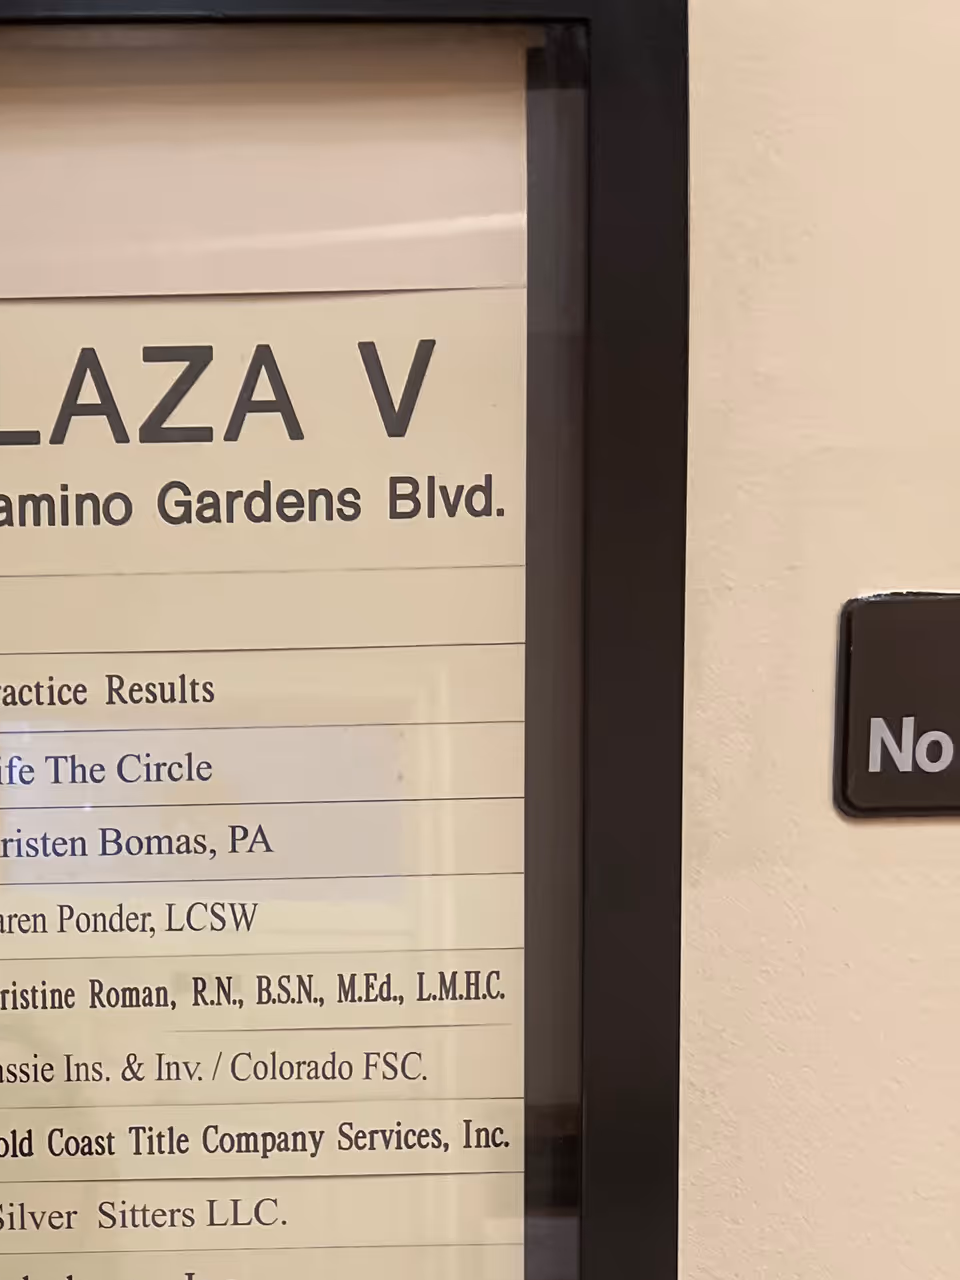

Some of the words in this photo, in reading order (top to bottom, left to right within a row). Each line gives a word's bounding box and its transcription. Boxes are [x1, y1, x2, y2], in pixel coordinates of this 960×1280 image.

[357, 338, 437, 438] V
[157, 479, 362, 526] Gardens
[388, 473, 505, 520] Blvd.
[105, 673, 215, 706] Results
[868, 716, 954, 773] No
[44, 754, 106, 785] The
[116, 751, 213, 784] Circle
[98, 827, 217, 861] Bomas,
[227, 824, 275, 854] PA
[56, 902, 156, 939] Ponder,
[164, 901, 259, 932] LCSW
[88, 978, 177, 1011] Roman,
[191, 975, 244, 1010] R.N.,
[255, 974, 325, 1008] B.S.N.,
[336, 972, 405, 1006] M.Ed.,
[416, 970, 506, 1002] L.M.H.C.
[63, 1053, 110, 1083] Ins.
[121, 1052, 146, 1082] &
[155, 1052, 203, 1082] Inv.
[230, 1050, 354, 1082] Colorado
[362, 1051, 427, 1081] FSC.
[47, 1127, 116, 1157] Coast
[128, 1125, 190, 1156] Title
[202, 1124, 326, 1159] Company
[337, 1120, 450, 1153] Services,
[462, 1119, 511, 1149] Inc.
[98, 1199, 196, 1229] Sitters
[205, 1197, 287, 1227] LLC.
